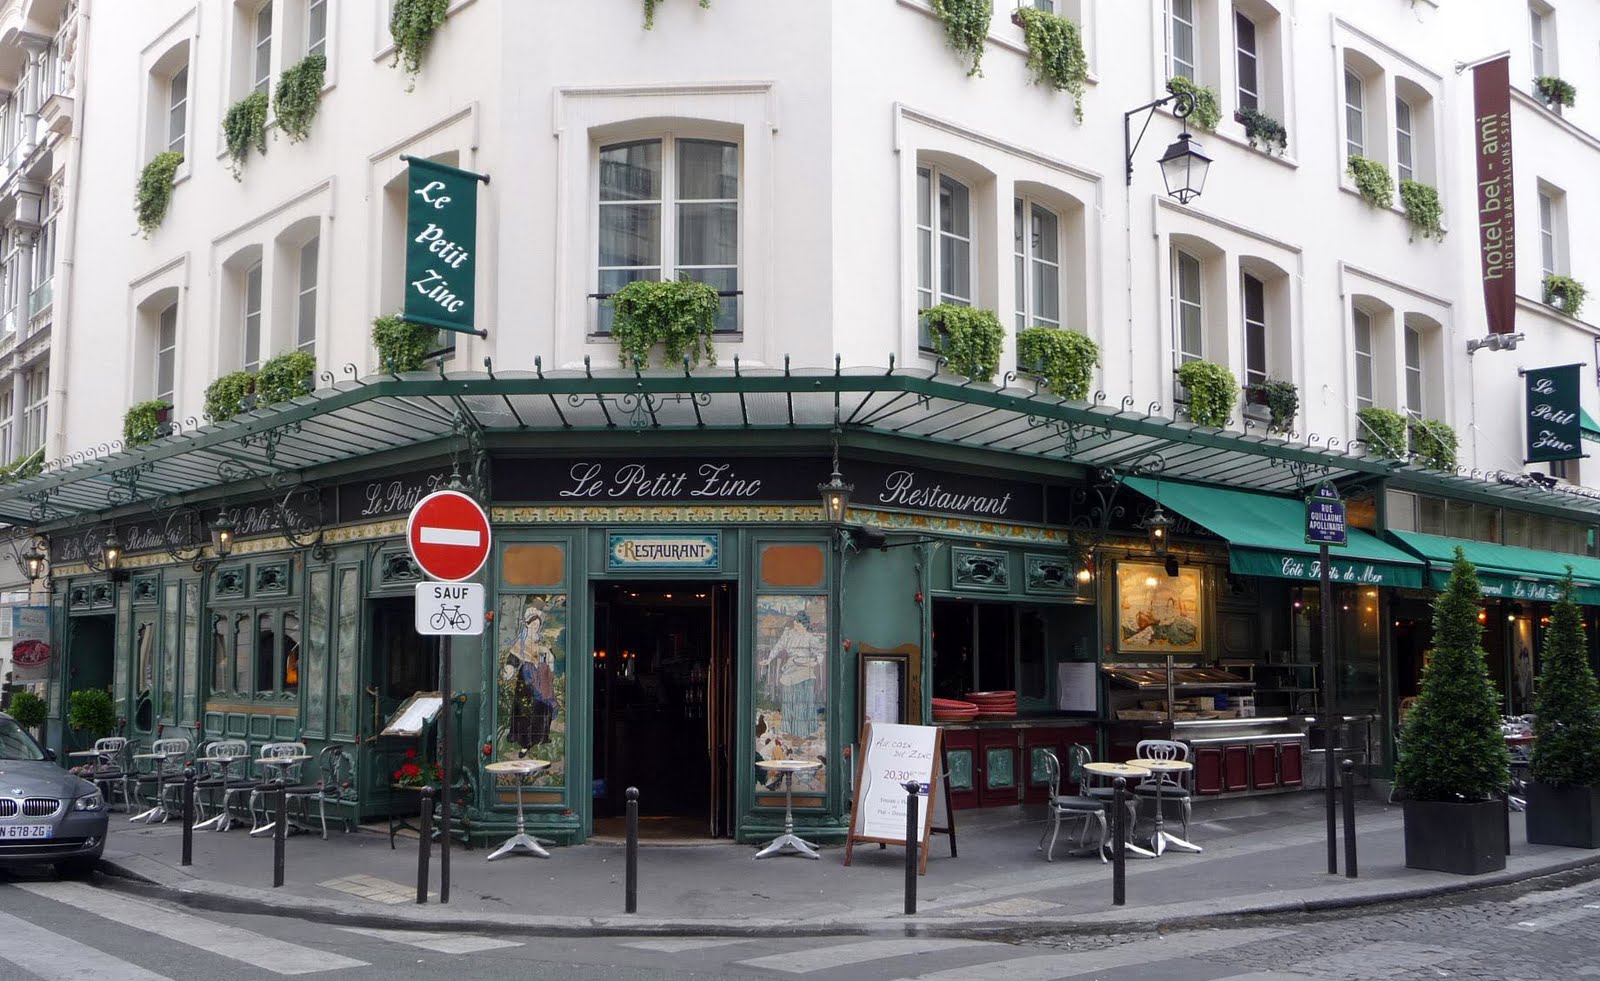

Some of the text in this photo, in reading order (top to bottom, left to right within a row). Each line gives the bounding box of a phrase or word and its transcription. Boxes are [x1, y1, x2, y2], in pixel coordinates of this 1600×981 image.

[1476, 113, 1498, 156] ami
[414, 181, 451, 209] Le
[1479, 176, 1500, 213] bel
[1480, 216, 1503, 280] hotel
[412, 269, 464, 312] Zinc
[1531, 379, 1557, 395] Le
[1531, 404, 1576, 425] Petit
[1532, 430, 1575, 451] Zinc
[559, 462, 761, 497] Le Petit Zinc
[879, 470, 1012, 514] Restaurant
[361, 483, 383, 515] Le
[384, 481, 422, 512] Petit
[1321, 504, 1333, 513] RUE
[242, 506, 270, 534] Petit
[1309, 521, 1344, 532] APOLLINAIRE
[1311, 512, 1342, 523] GUILLAUME
[618, 541, 706, 561] RESTAURANT
[1282, 557, 1383, 583] Côté Frits de Mer
[434, 587, 469, 600] SAUF
[1512, 581, 1525, 597] Le
[1527, 582, 1546, 599] Petit
